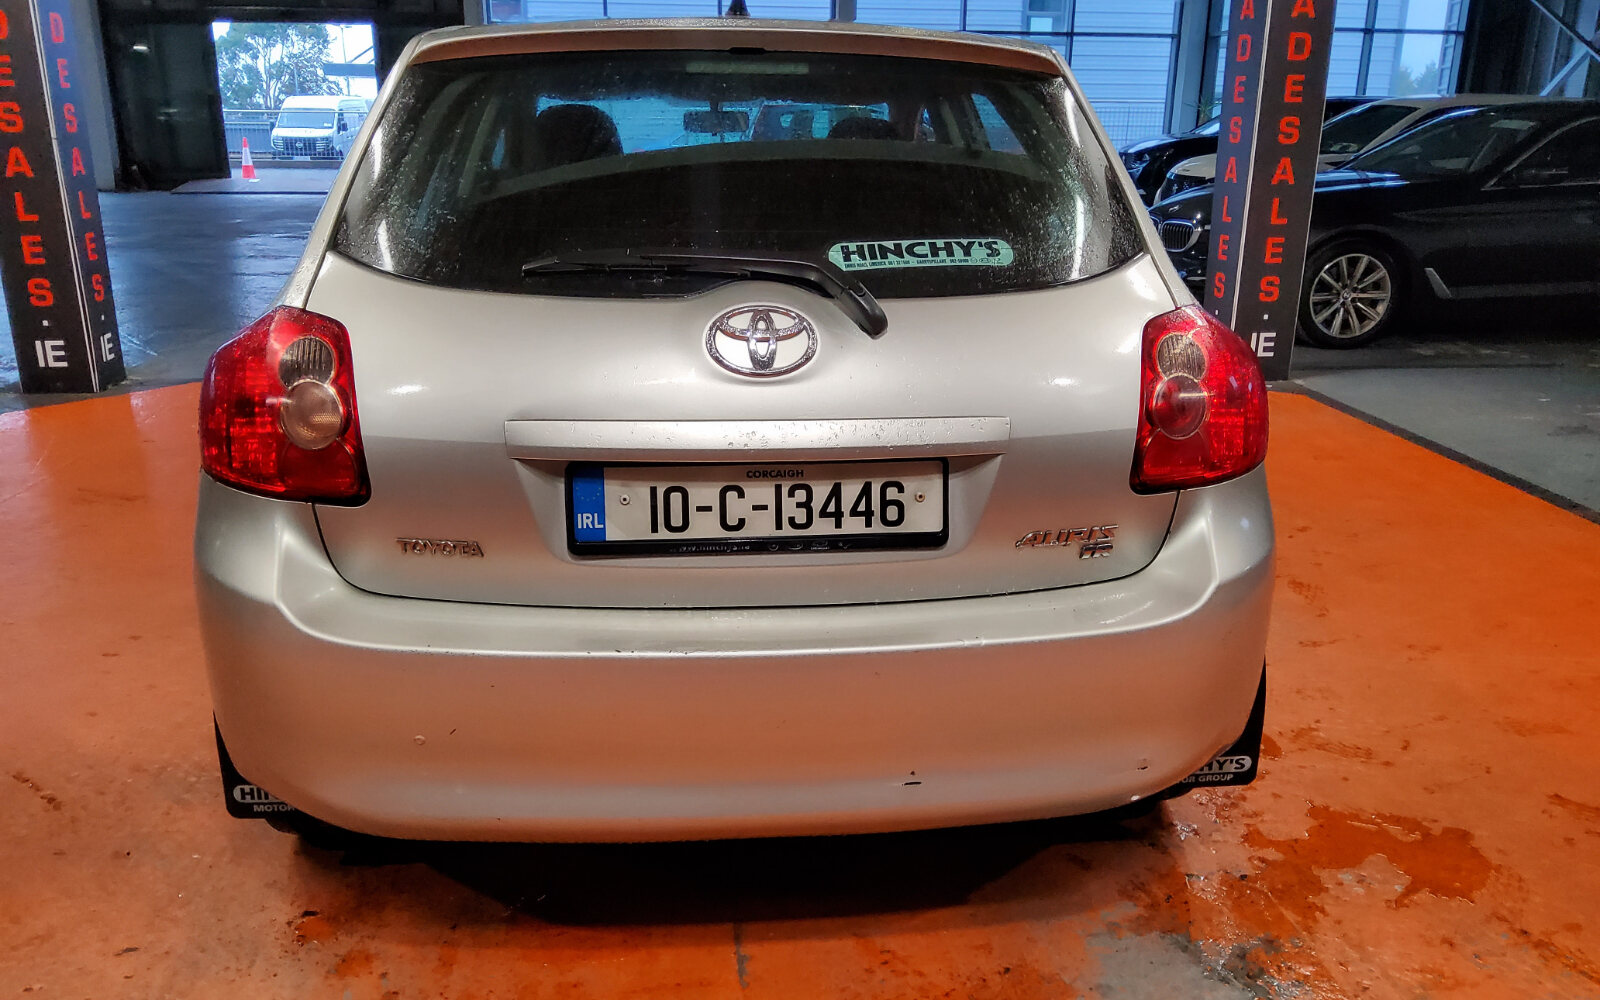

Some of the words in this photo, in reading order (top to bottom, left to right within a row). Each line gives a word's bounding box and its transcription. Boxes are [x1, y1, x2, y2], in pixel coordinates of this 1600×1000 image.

[840, 240, 1001, 263] HINCHY'S
[746, 469, 804, 480] CORCAIGH
[577, 513, 604, 529] IRL
[1015, 524, 1119, 549] AURIS
[396, 537, 484, 558] TOYOTA
[1199, 774, 1234, 782] GROUP
